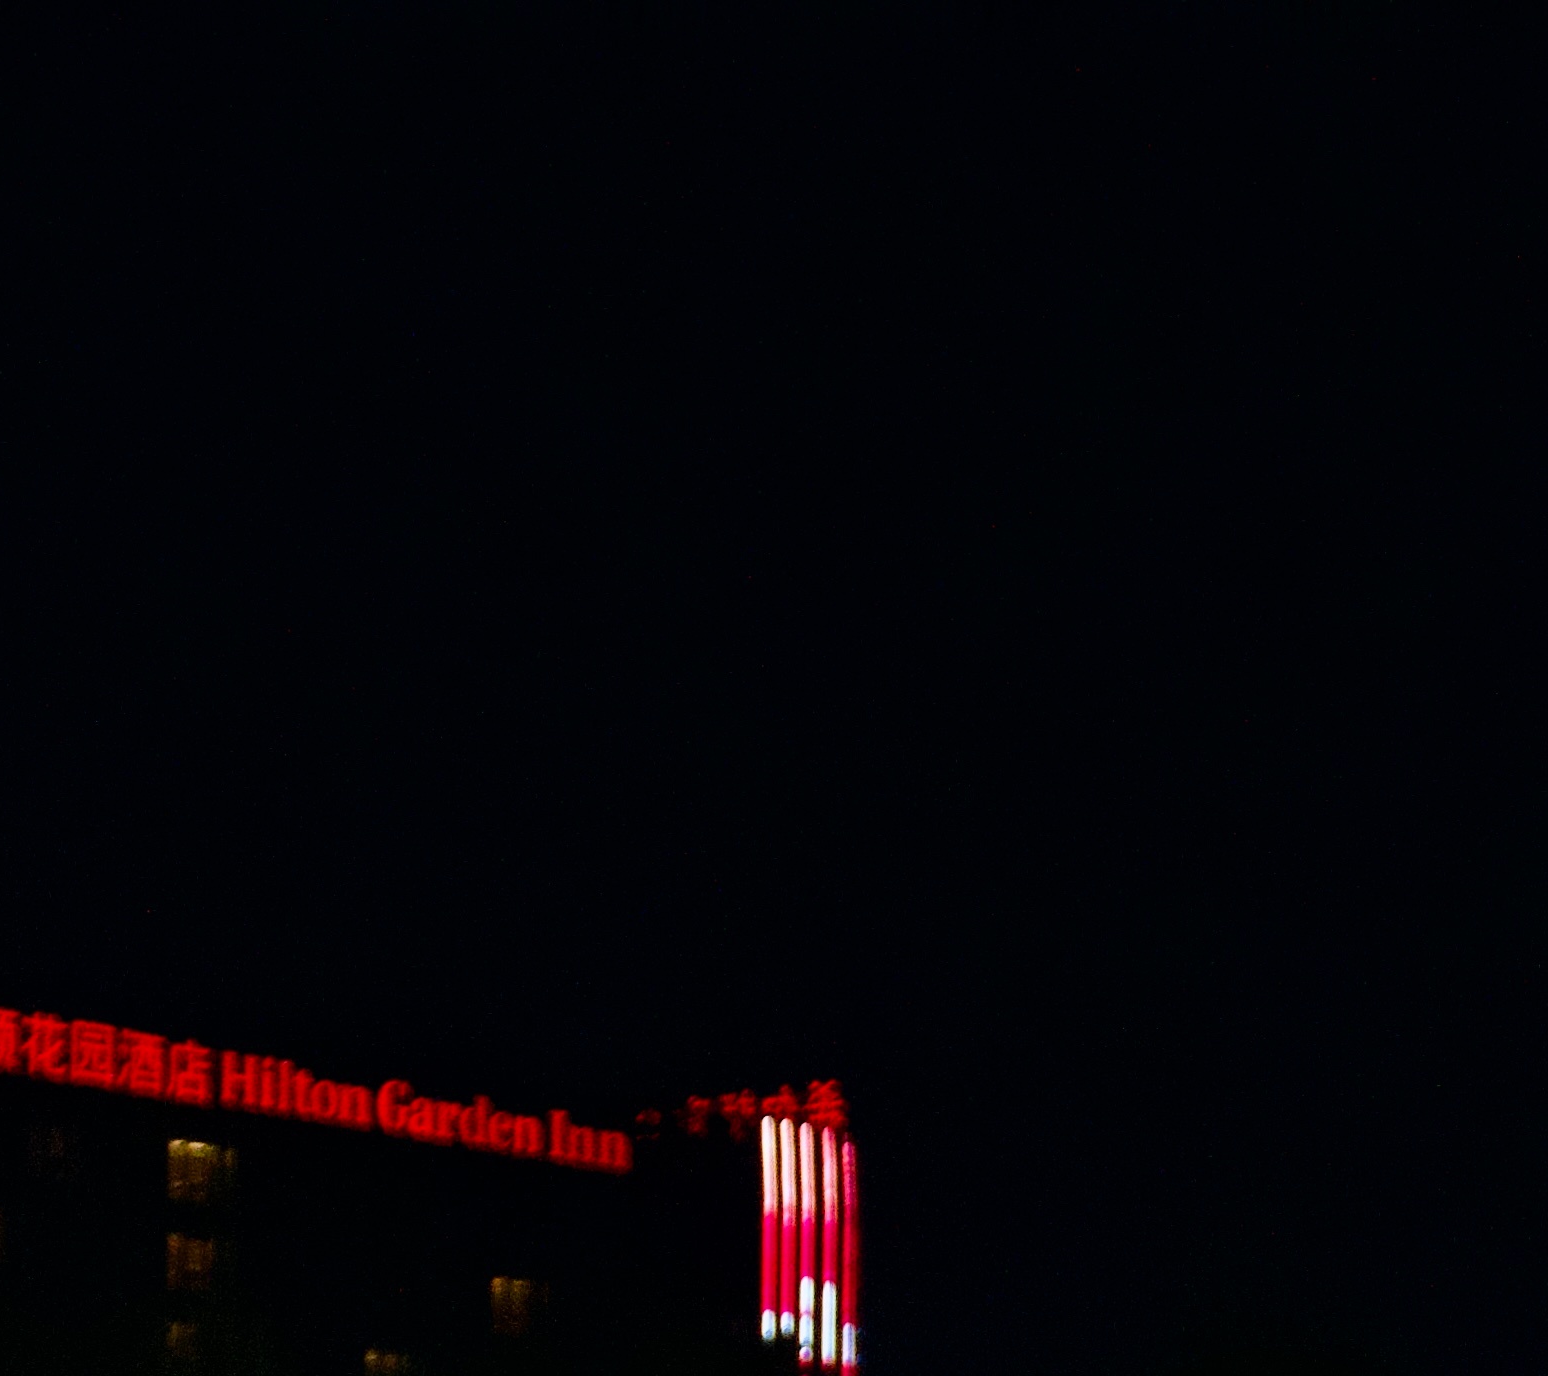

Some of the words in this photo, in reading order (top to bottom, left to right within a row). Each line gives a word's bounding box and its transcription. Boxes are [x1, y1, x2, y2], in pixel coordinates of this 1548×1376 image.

[221, 1049, 373, 1131] Hilton
[376, 1079, 547, 1161] Garden
[548, 1108, 634, 1175] Inn
